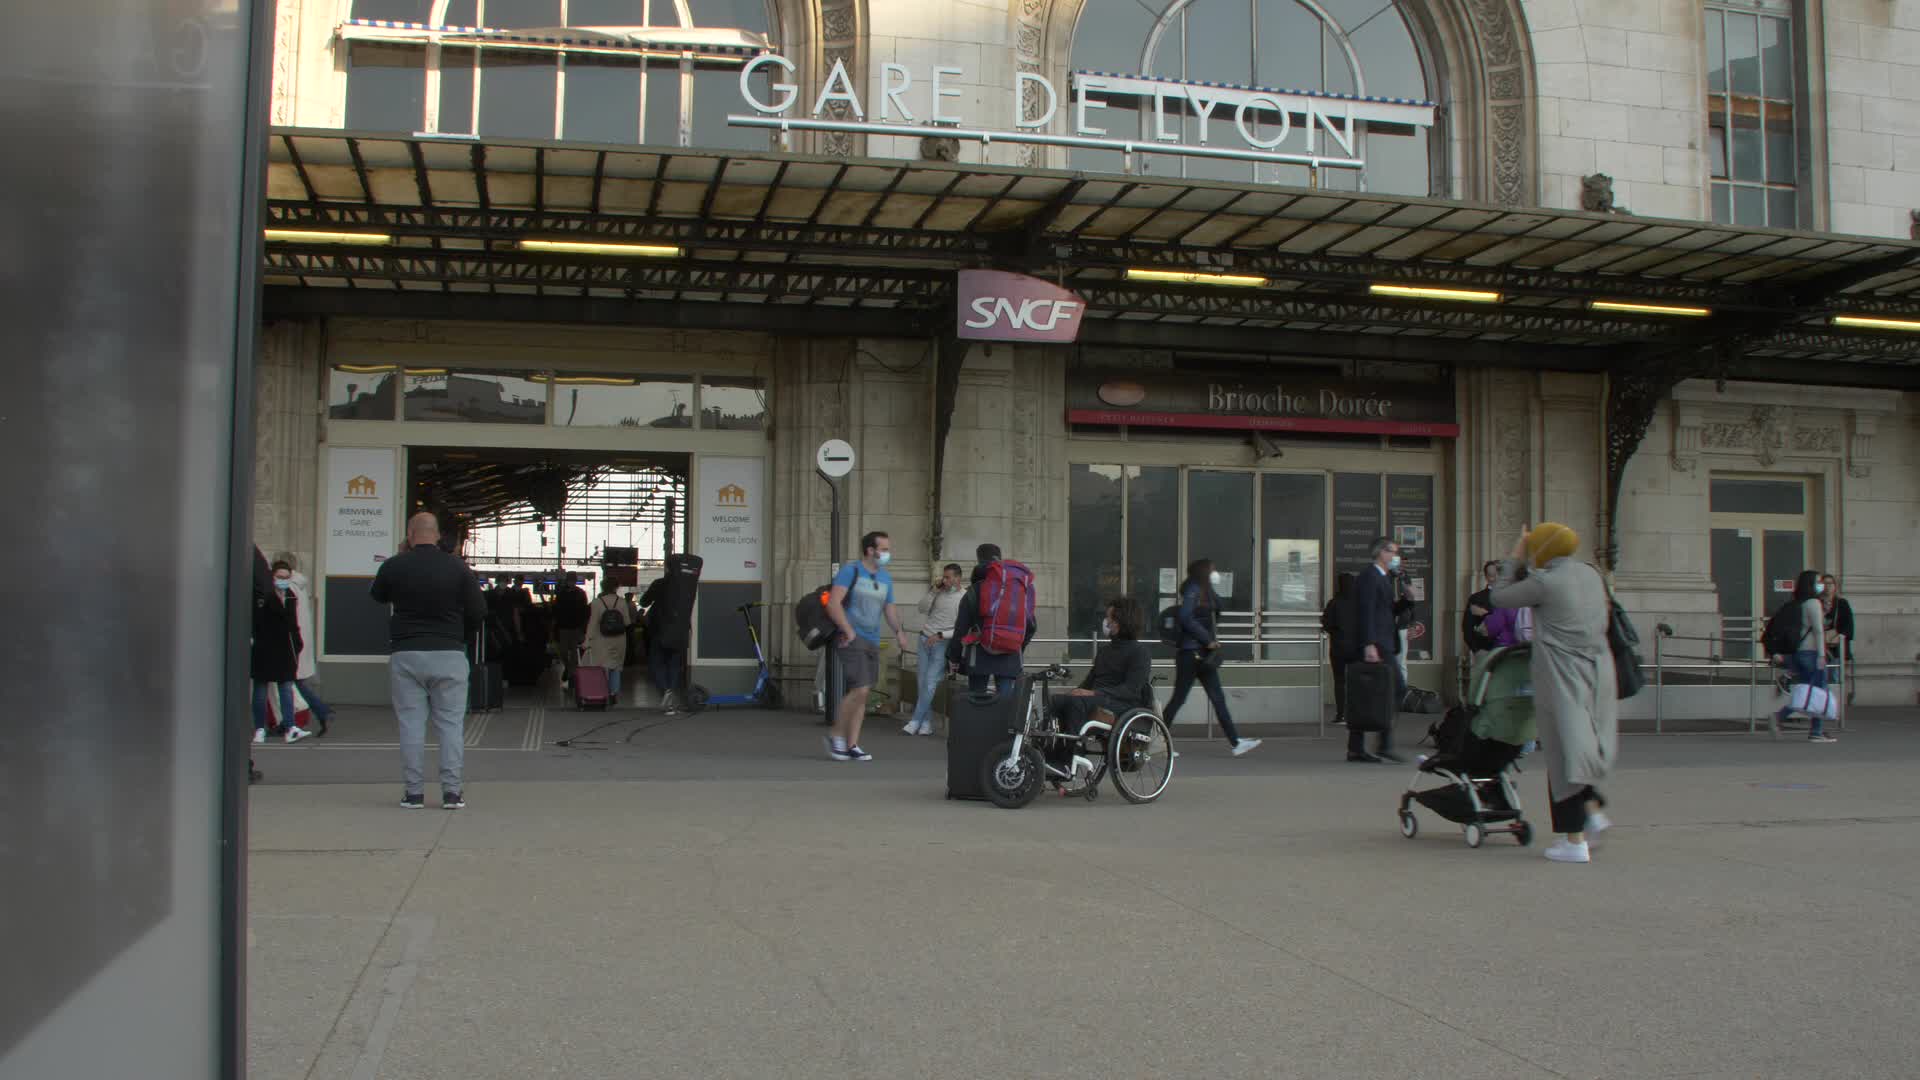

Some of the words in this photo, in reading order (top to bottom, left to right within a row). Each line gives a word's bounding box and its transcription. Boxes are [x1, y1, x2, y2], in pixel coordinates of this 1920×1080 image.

[740, 54, 962, 123] GARE
[1016, 72, 1106, 135] DE
[1156, 84, 1354, 158] LYON
[965, 297, 1079, 331] SNCF
[1208, 384, 1305, 414] Brioche
[1319, 391, 1392, 416] Dorée
[712, 515, 751, 523] WELCOME
